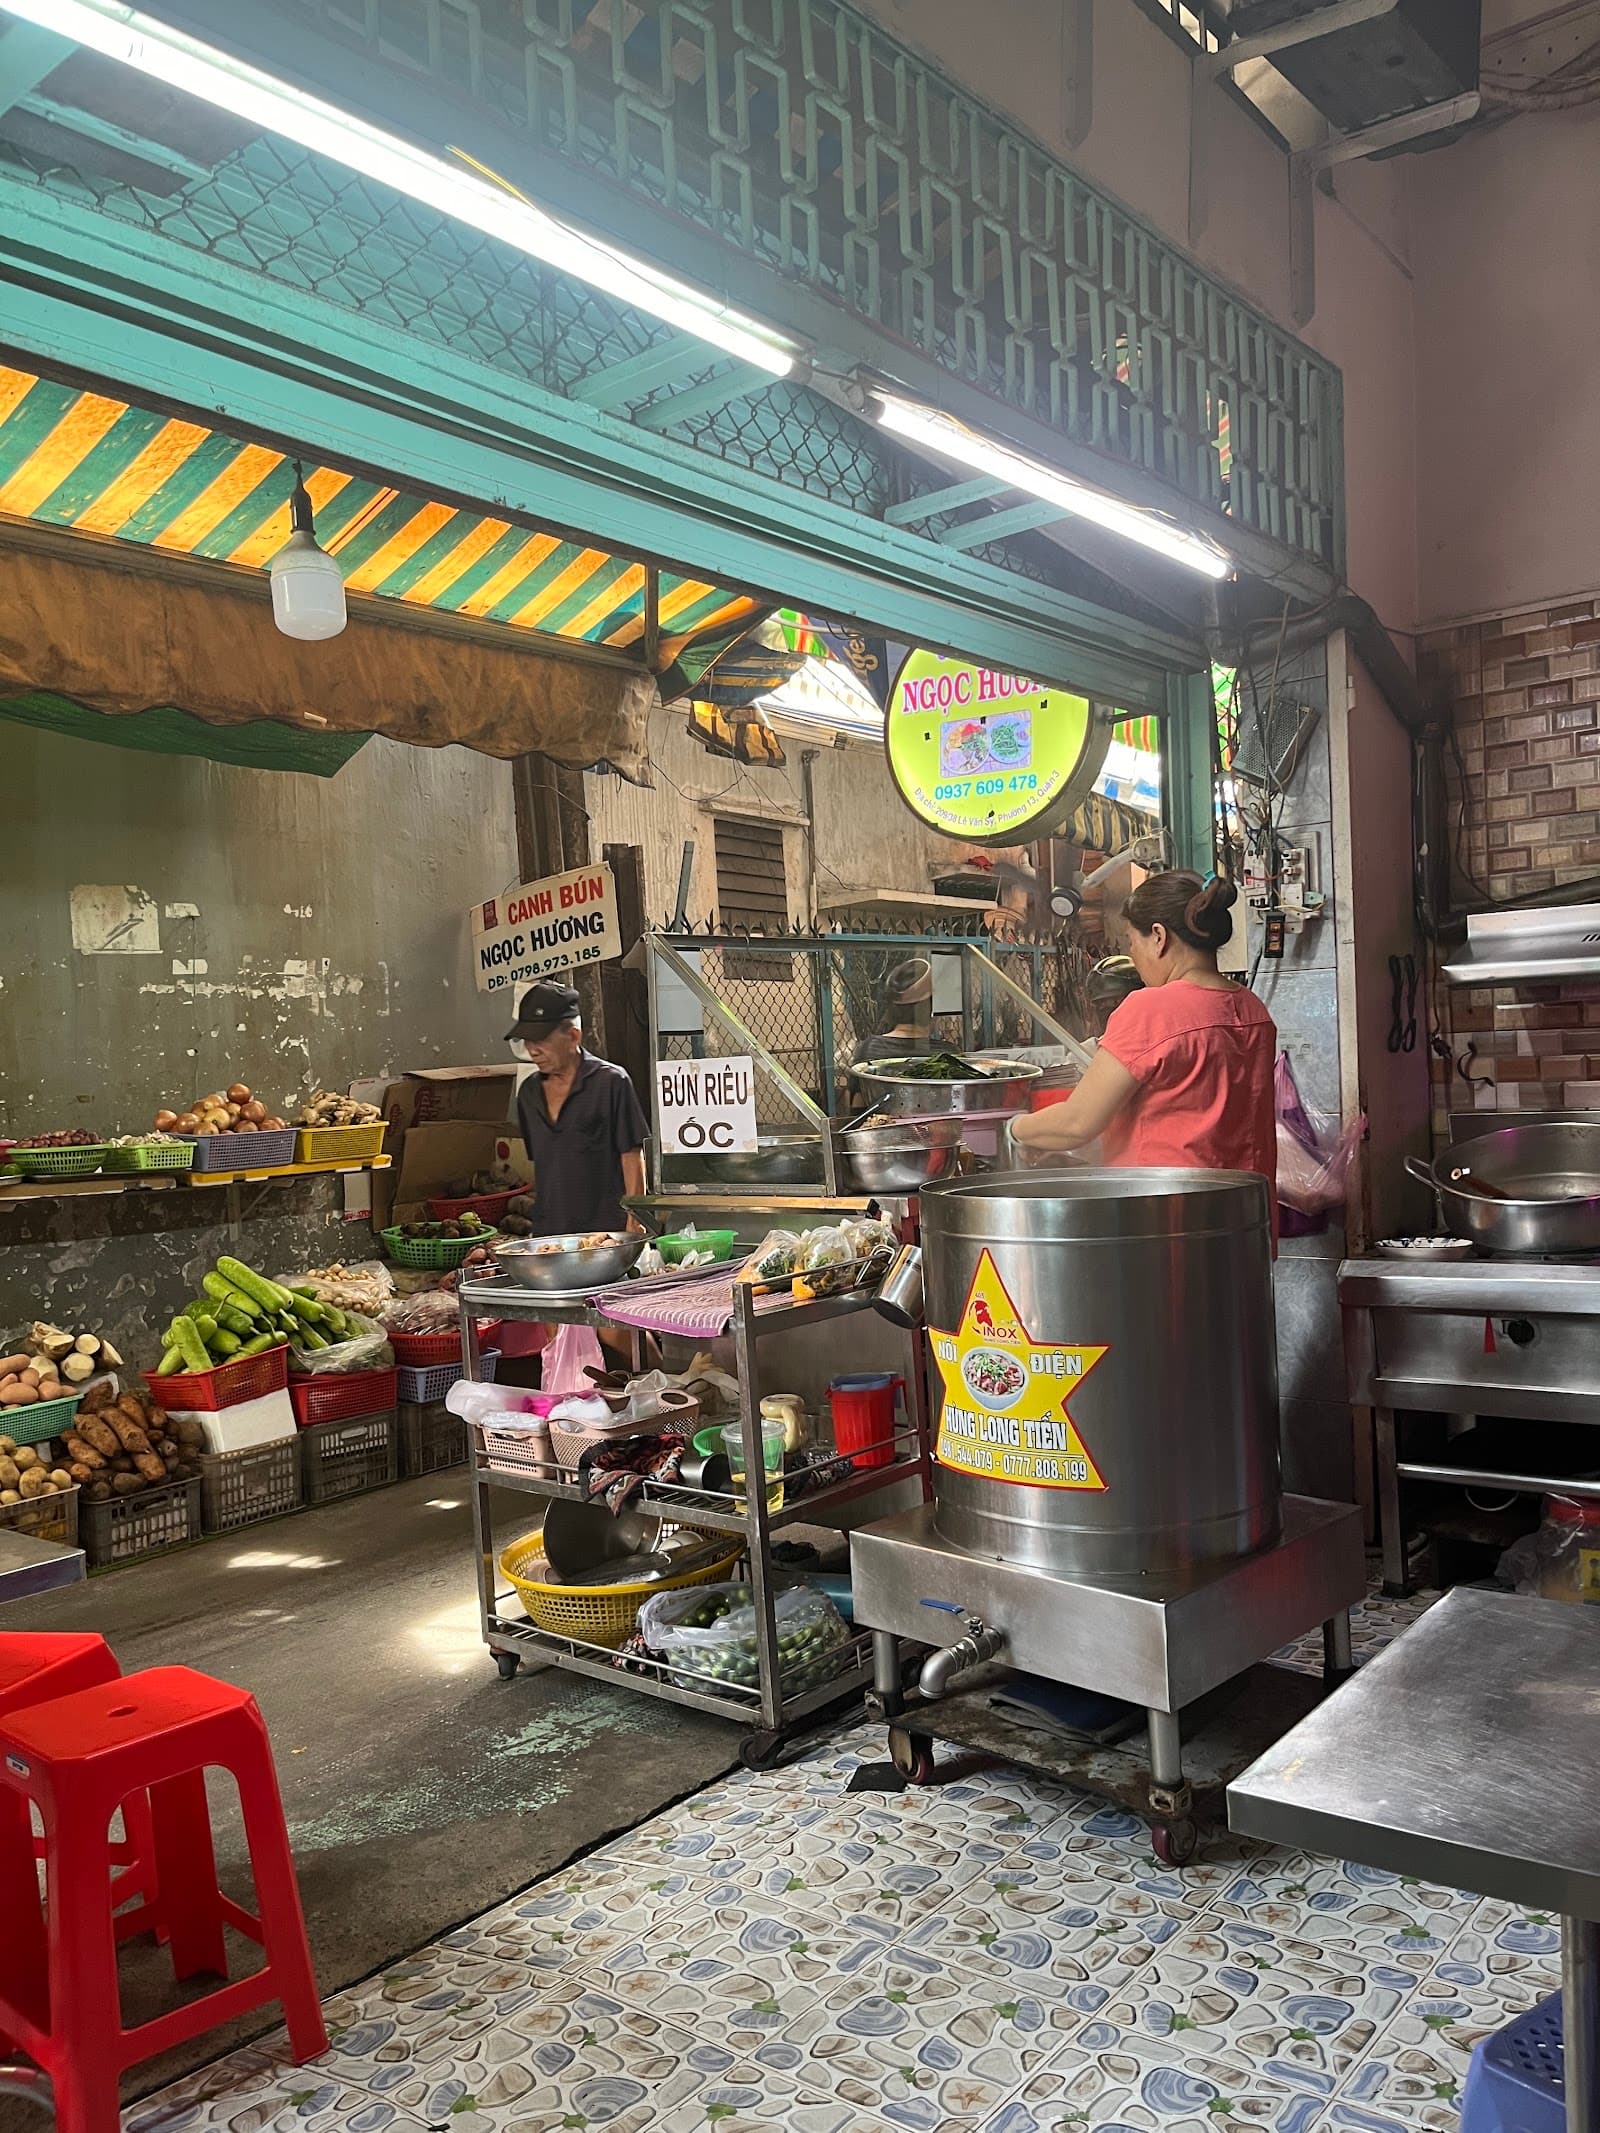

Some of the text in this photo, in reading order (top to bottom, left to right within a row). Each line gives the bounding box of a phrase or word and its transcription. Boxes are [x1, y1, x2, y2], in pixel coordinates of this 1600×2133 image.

[902, 671, 971, 715] NGỌC
[934, 774, 1038, 800] 0937 609 478
[508, 890, 554, 926] CANH
[559, 875, 604, 909] BÚN
[480, 935, 525, 970] NGỌC
[530, 911, 605, 952] HƯƠNG
[488, 946, 601, 990] DĐ: 0798.973.185
[661, 1064, 748, 1107] BÚN RIÊU
[678, 1116, 735, 1148] ỐC
[983, 1326, 1017, 1340] INOX
[1029, 1350, 1083, 1379] ĐIỆN
[944, 1401, 1067, 1451] HÙNG LONG TIẾN
[1003, 1454, 1088, 1481] 0777.808.199
